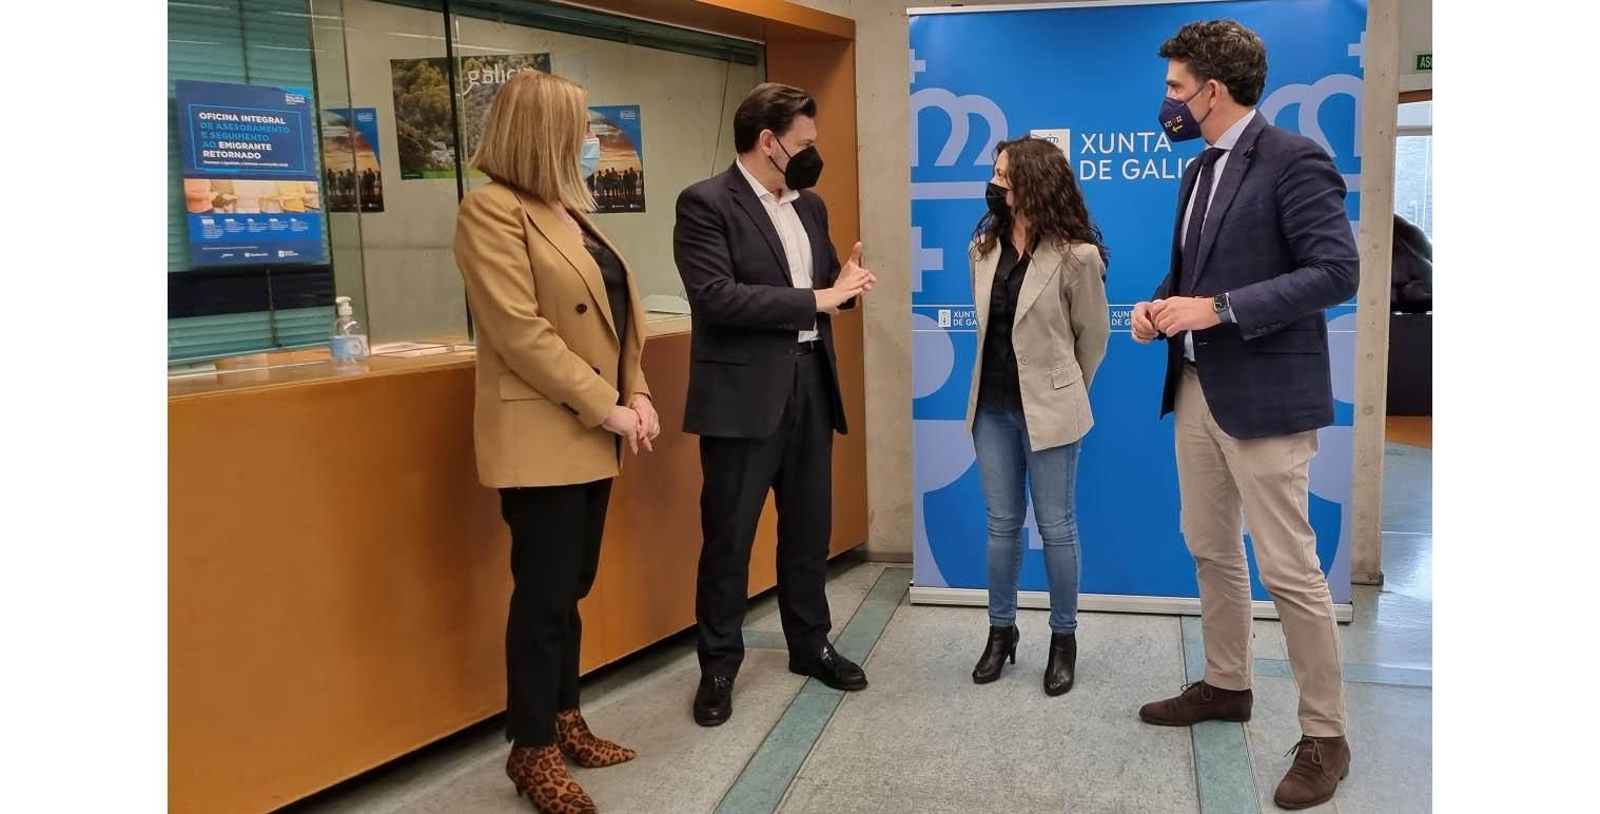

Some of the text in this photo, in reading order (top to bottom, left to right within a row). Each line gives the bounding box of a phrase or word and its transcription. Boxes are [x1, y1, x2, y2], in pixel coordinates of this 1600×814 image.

[1420, 56, 1432, 68] AS
[455, 63, 534, 97] galic
[199, 112, 286, 124] OFICINA INTEGRAL
[200, 122, 290, 133] DE ASESORAMENTO
[210, 132, 270, 142] SEGUIMENTO
[202, 141, 272, 151] AO EMIGRANTE
[1080, 132, 1172, 154] XUNTA
[203, 150, 261, 159] RETORNADO
[1080, 157, 1196, 180] DE GALI
[1112, 310, 1134, 318] XUN
